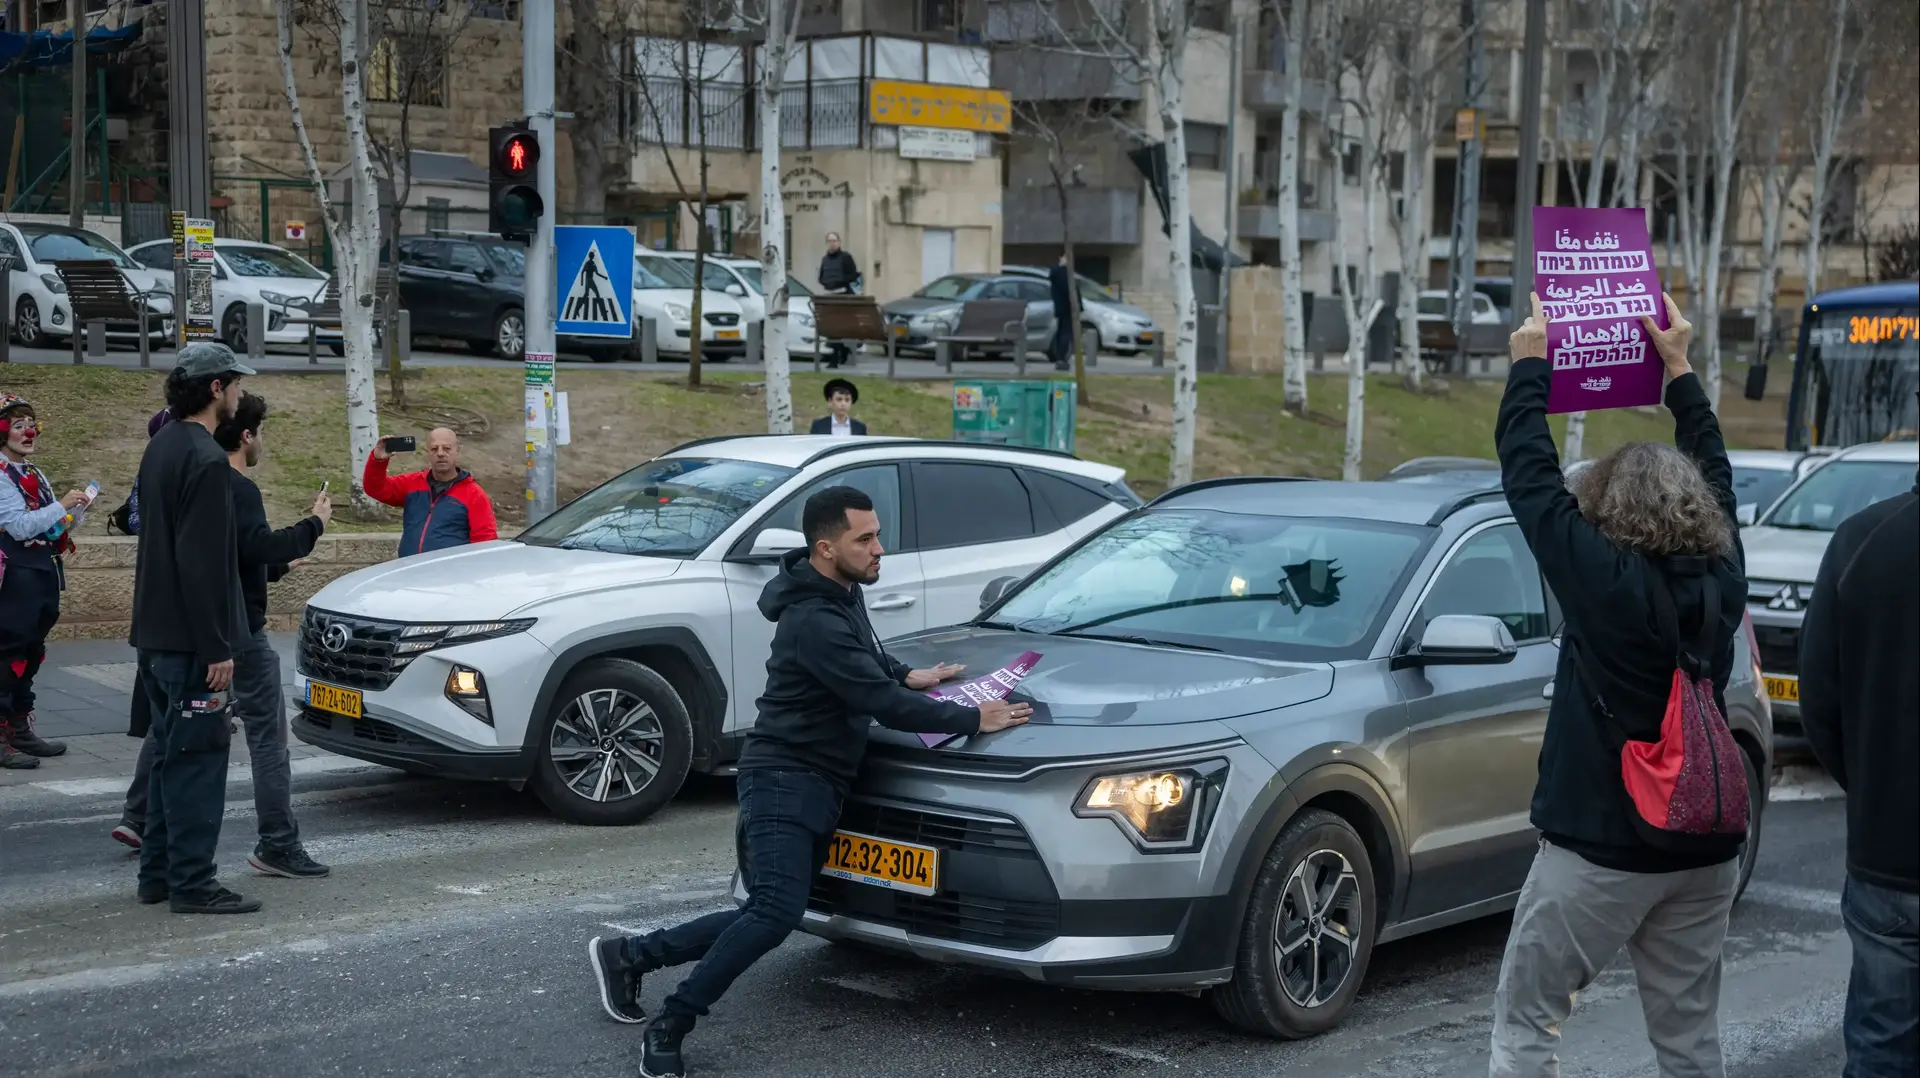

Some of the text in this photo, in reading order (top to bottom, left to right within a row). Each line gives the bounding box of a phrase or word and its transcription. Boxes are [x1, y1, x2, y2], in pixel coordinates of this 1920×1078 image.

[876, 86, 952, 118] ירושלים
[1555, 229, 1620, 250] نقف معًا
[1540, 255, 1643, 271] עומדות ביחד
[1546, 278, 1646, 303] ضد الجريمة
[1543, 299, 1652, 319] נגד הפשיעה
[1562, 322, 1641, 350] والإهمال
[1849, 316, 1878, 344] 304
[1557, 347, 1641, 368] וההפקרה
[826, 836, 927, 882] 12·32·304
